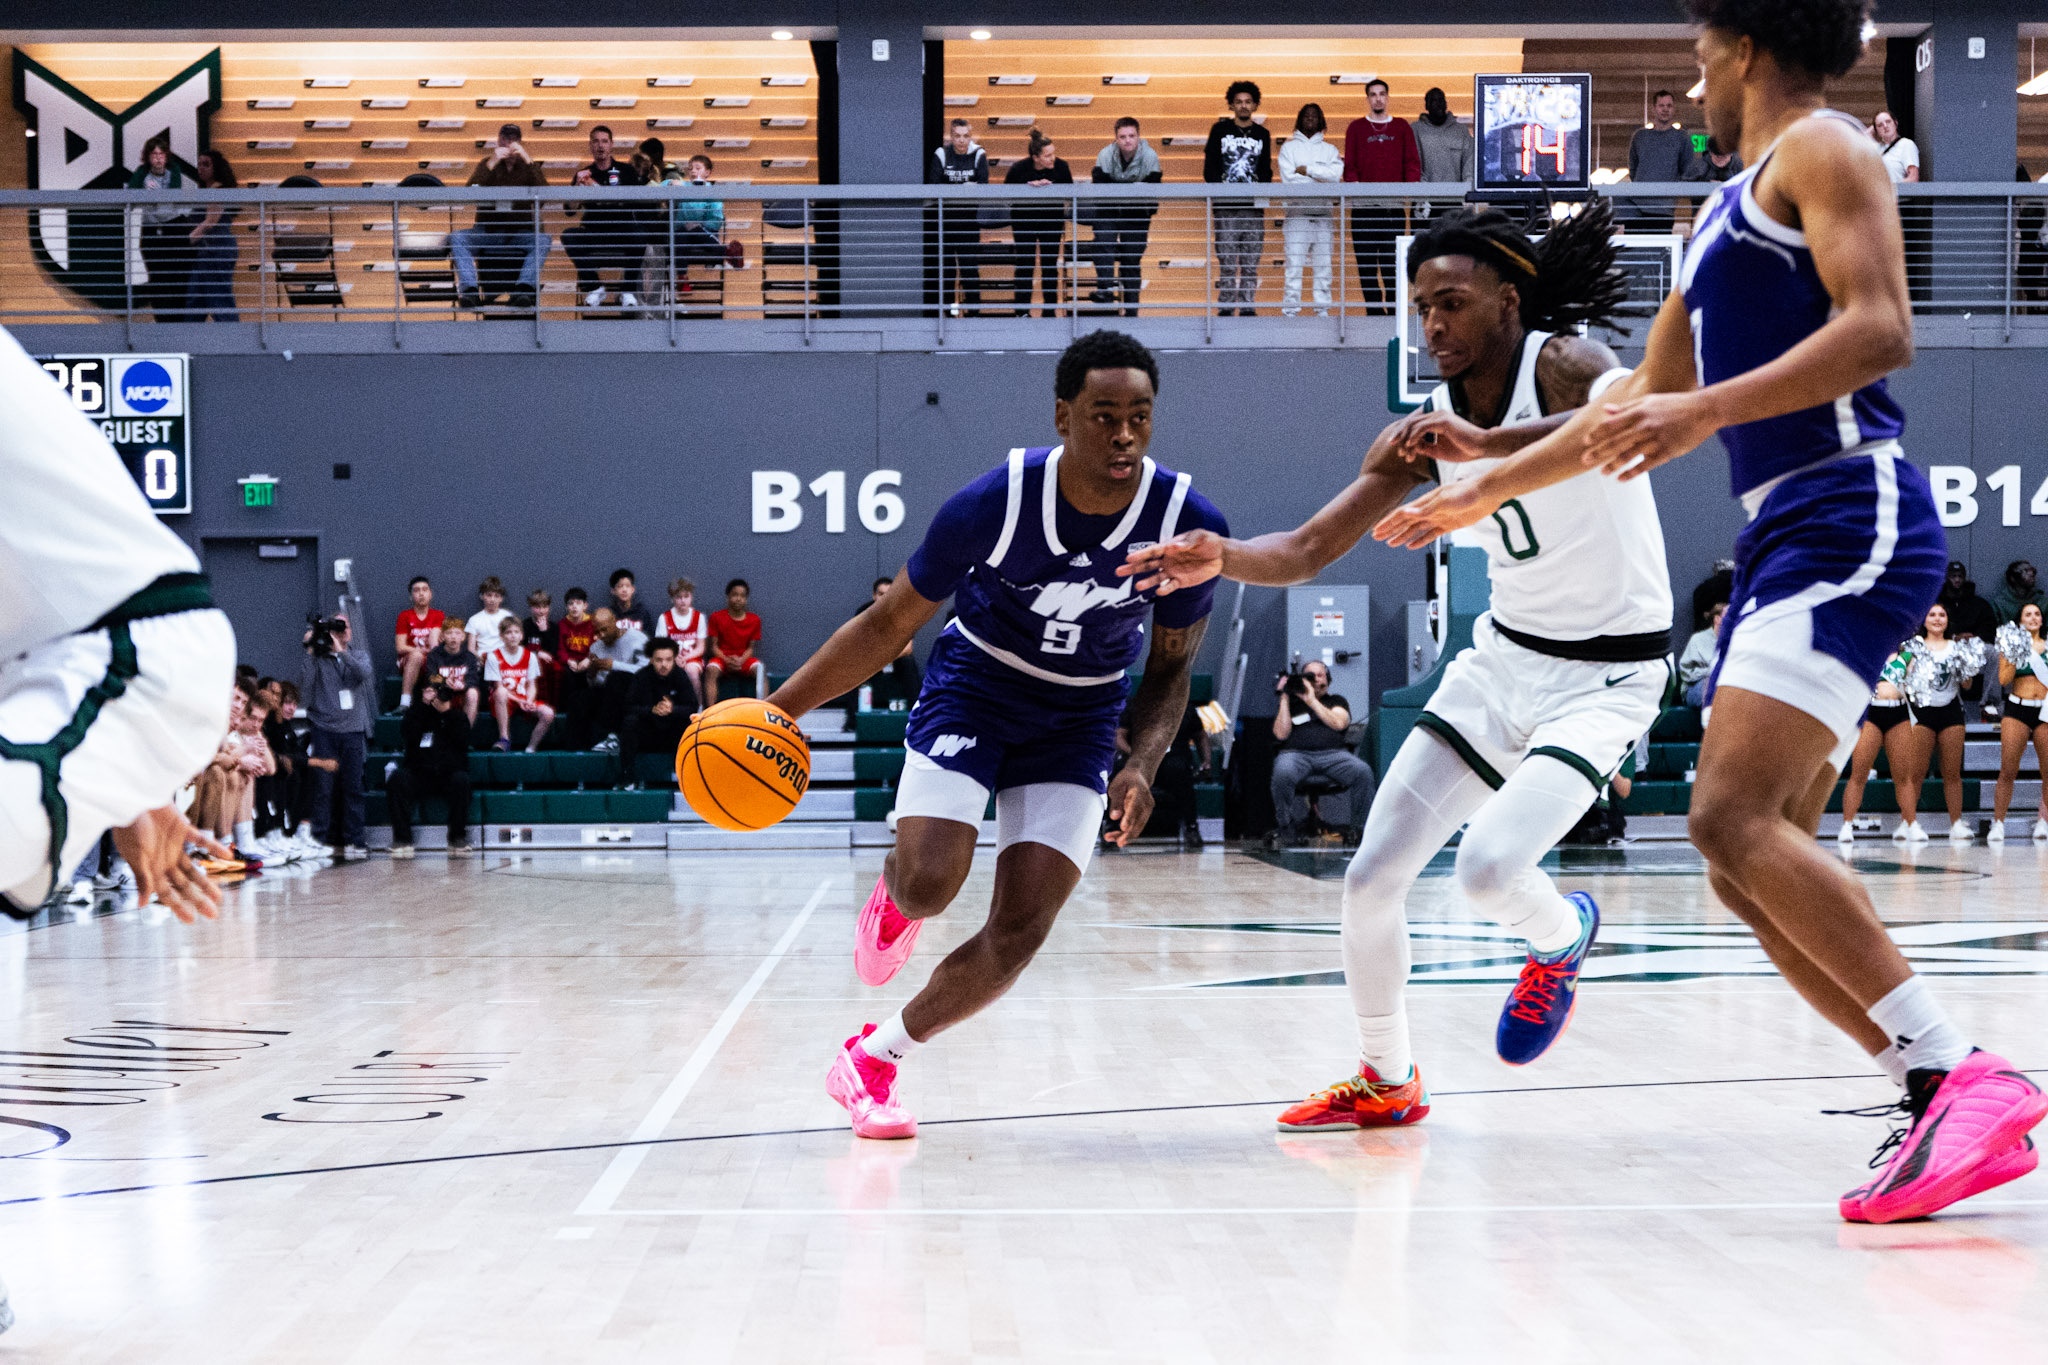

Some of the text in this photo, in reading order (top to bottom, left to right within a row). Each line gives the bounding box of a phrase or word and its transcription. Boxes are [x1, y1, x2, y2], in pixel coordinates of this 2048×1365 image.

[1522, 123, 1566, 176] 14
[125, 386, 172, 401] NCAA
[100, 420, 173, 444] GUEST
[145, 449, 177, 500] 0
[244, 483, 274, 507] EXIT
[752, 469, 905, 534] B16
[1491, 498, 1541, 561] 0
[1040, 619, 1082, 655] 9
[764, 710, 808, 747] CAA
[746, 734, 809, 796] Wilson
[261, 1049, 522, 1124] COURT
